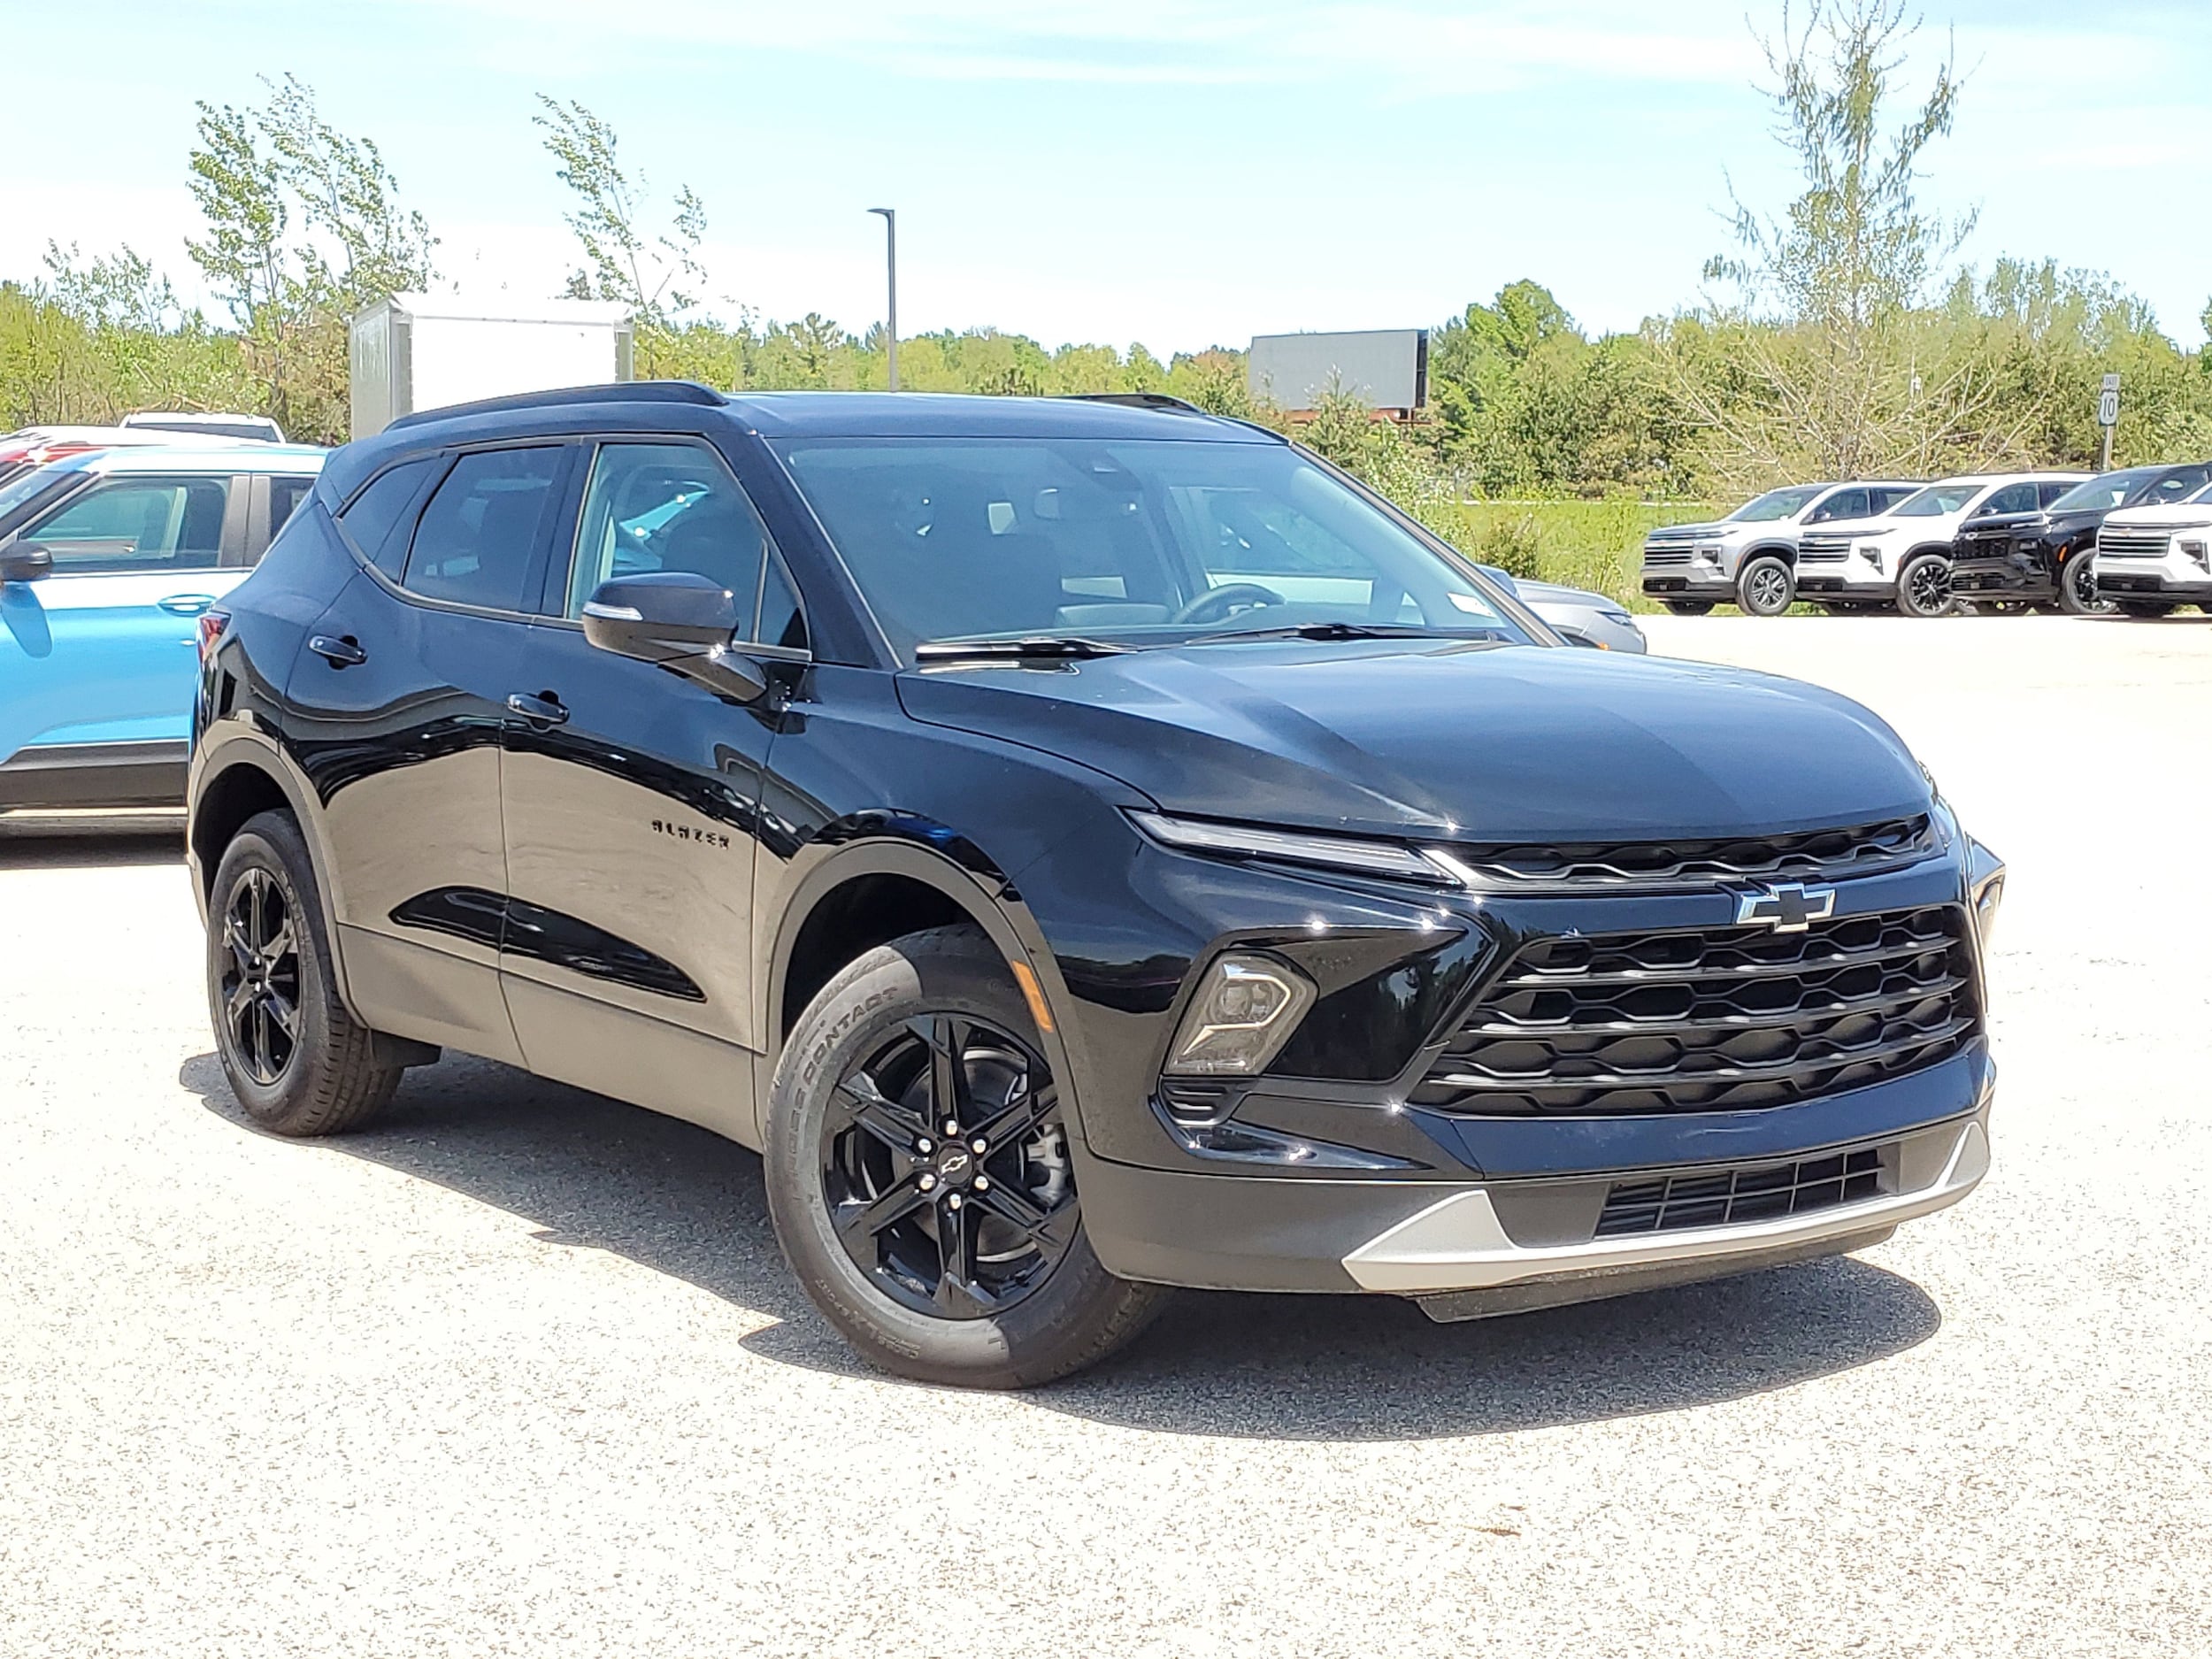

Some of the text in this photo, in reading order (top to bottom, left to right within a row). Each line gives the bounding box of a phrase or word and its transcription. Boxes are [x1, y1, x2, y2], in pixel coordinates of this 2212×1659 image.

[2103, 397, 2115, 417] 10
[651, 819, 729, 849] BLAZER
[803, 987, 898, 1086] CONTACT
